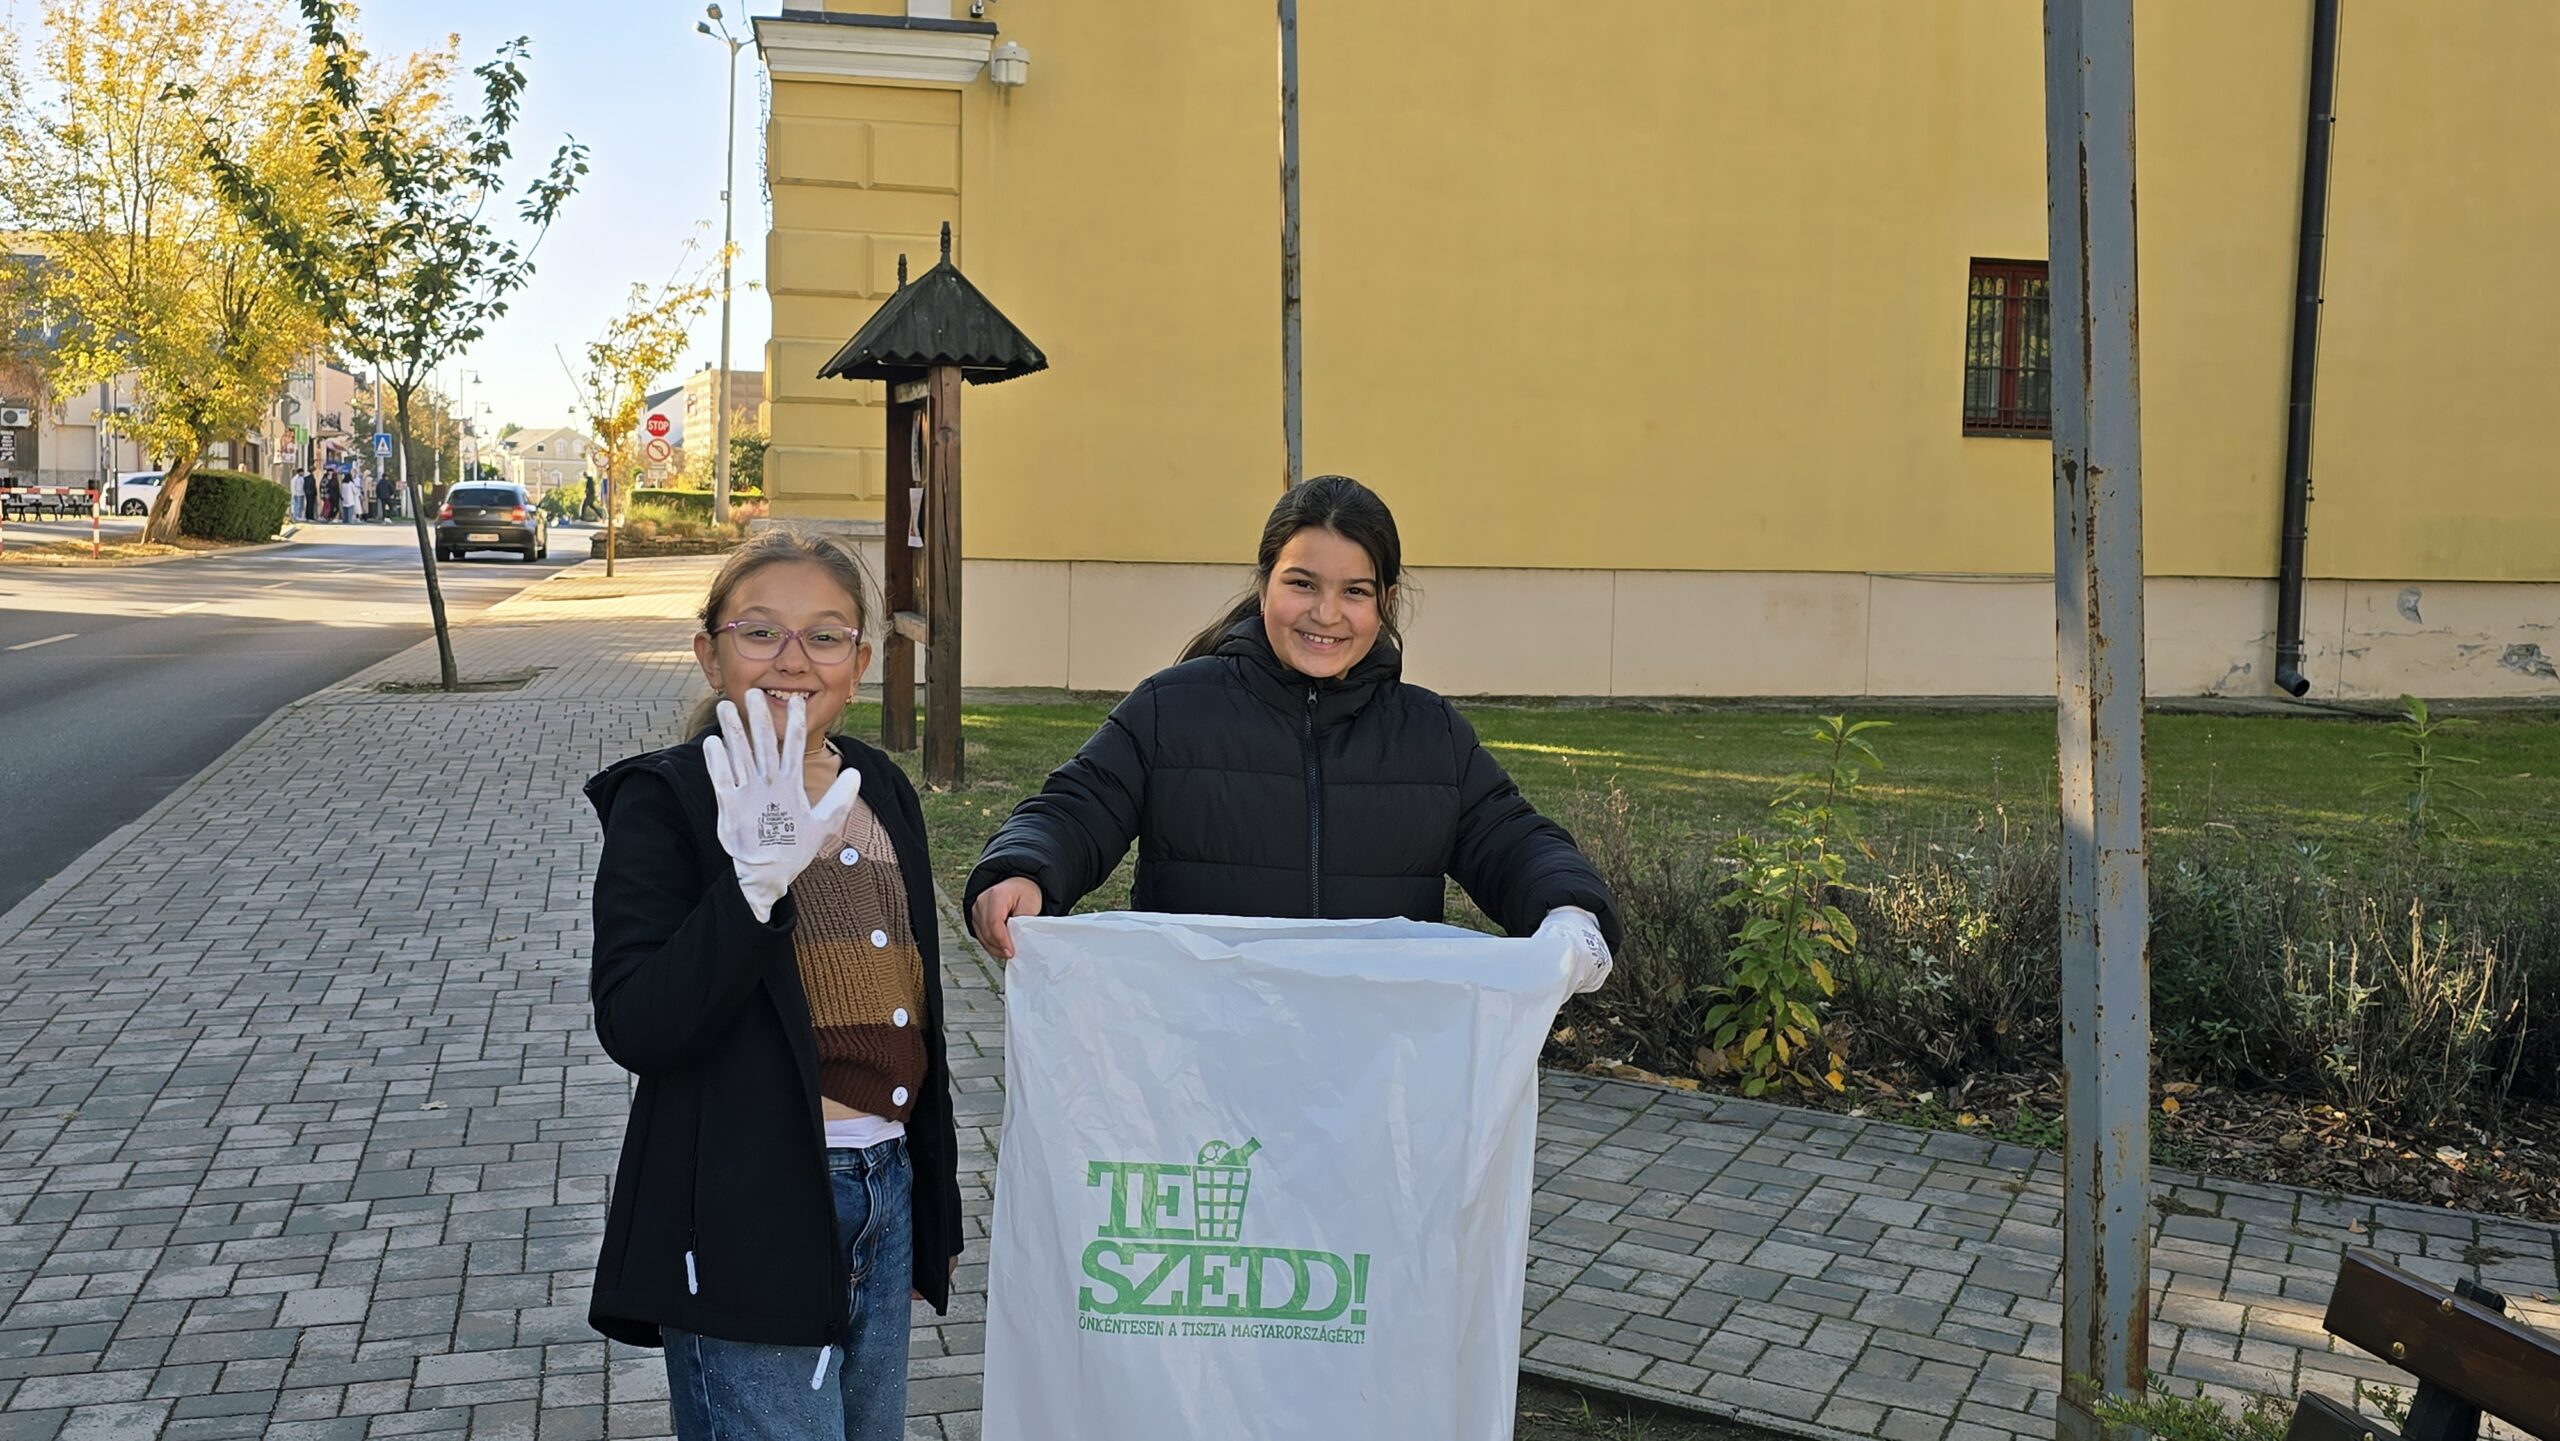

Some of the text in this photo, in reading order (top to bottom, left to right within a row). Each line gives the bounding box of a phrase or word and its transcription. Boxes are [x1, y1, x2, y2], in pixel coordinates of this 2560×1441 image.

[648, 420, 670, 431] STOP
[784, 822, 795, 832] 09
[1086, 1161, 1195, 1239] TE
[1078, 1240, 1371, 1325] SZEDD!
[1078, 1312, 1366, 1344] ÖNKÉNTESEN A TISZTA MAGYARORSZÁGÉRT!
